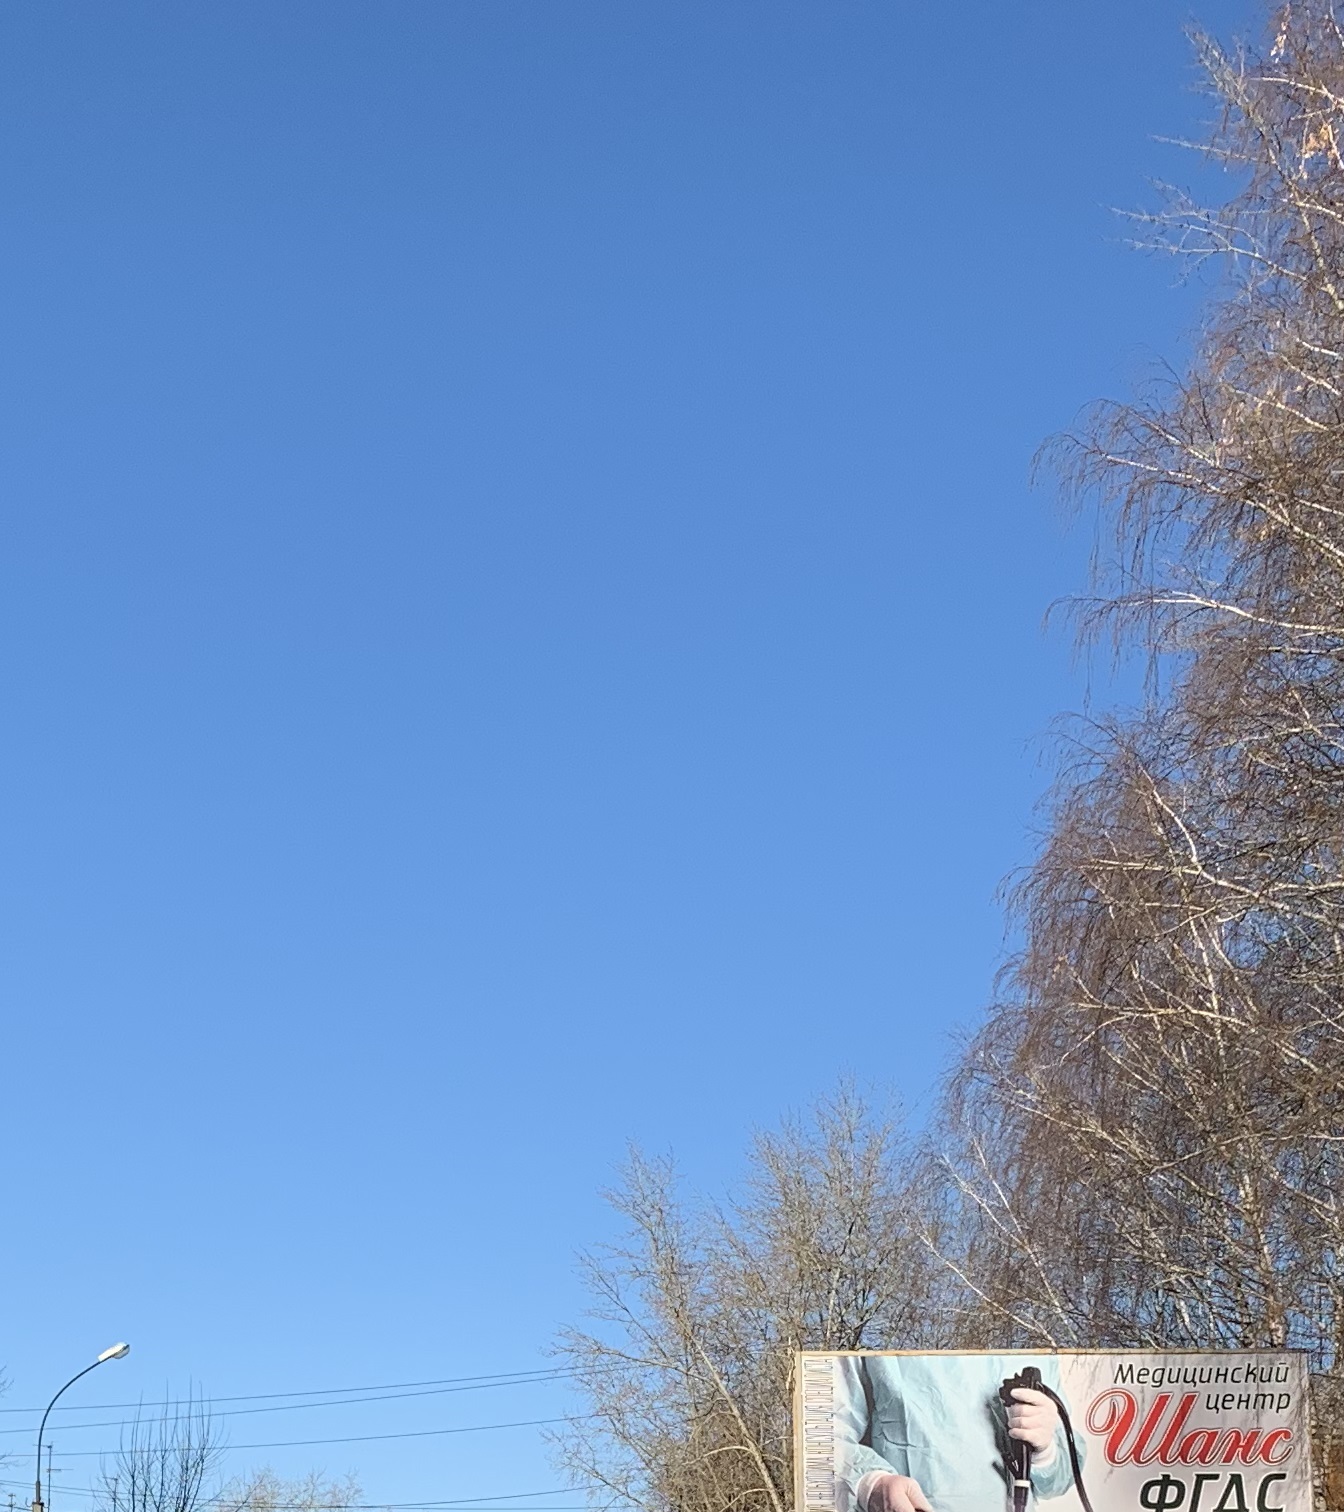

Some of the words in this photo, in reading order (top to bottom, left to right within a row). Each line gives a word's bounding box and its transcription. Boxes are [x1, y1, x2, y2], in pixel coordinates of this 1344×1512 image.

[1113, 1362, 1290, 1386] Медицинский
[1204, 1391, 1291, 1413] центр
[805, 1405, 834, 1455] КОНСУЛЬТАЦИЯ
[1085, 1388, 1294, 1468] Шанс
